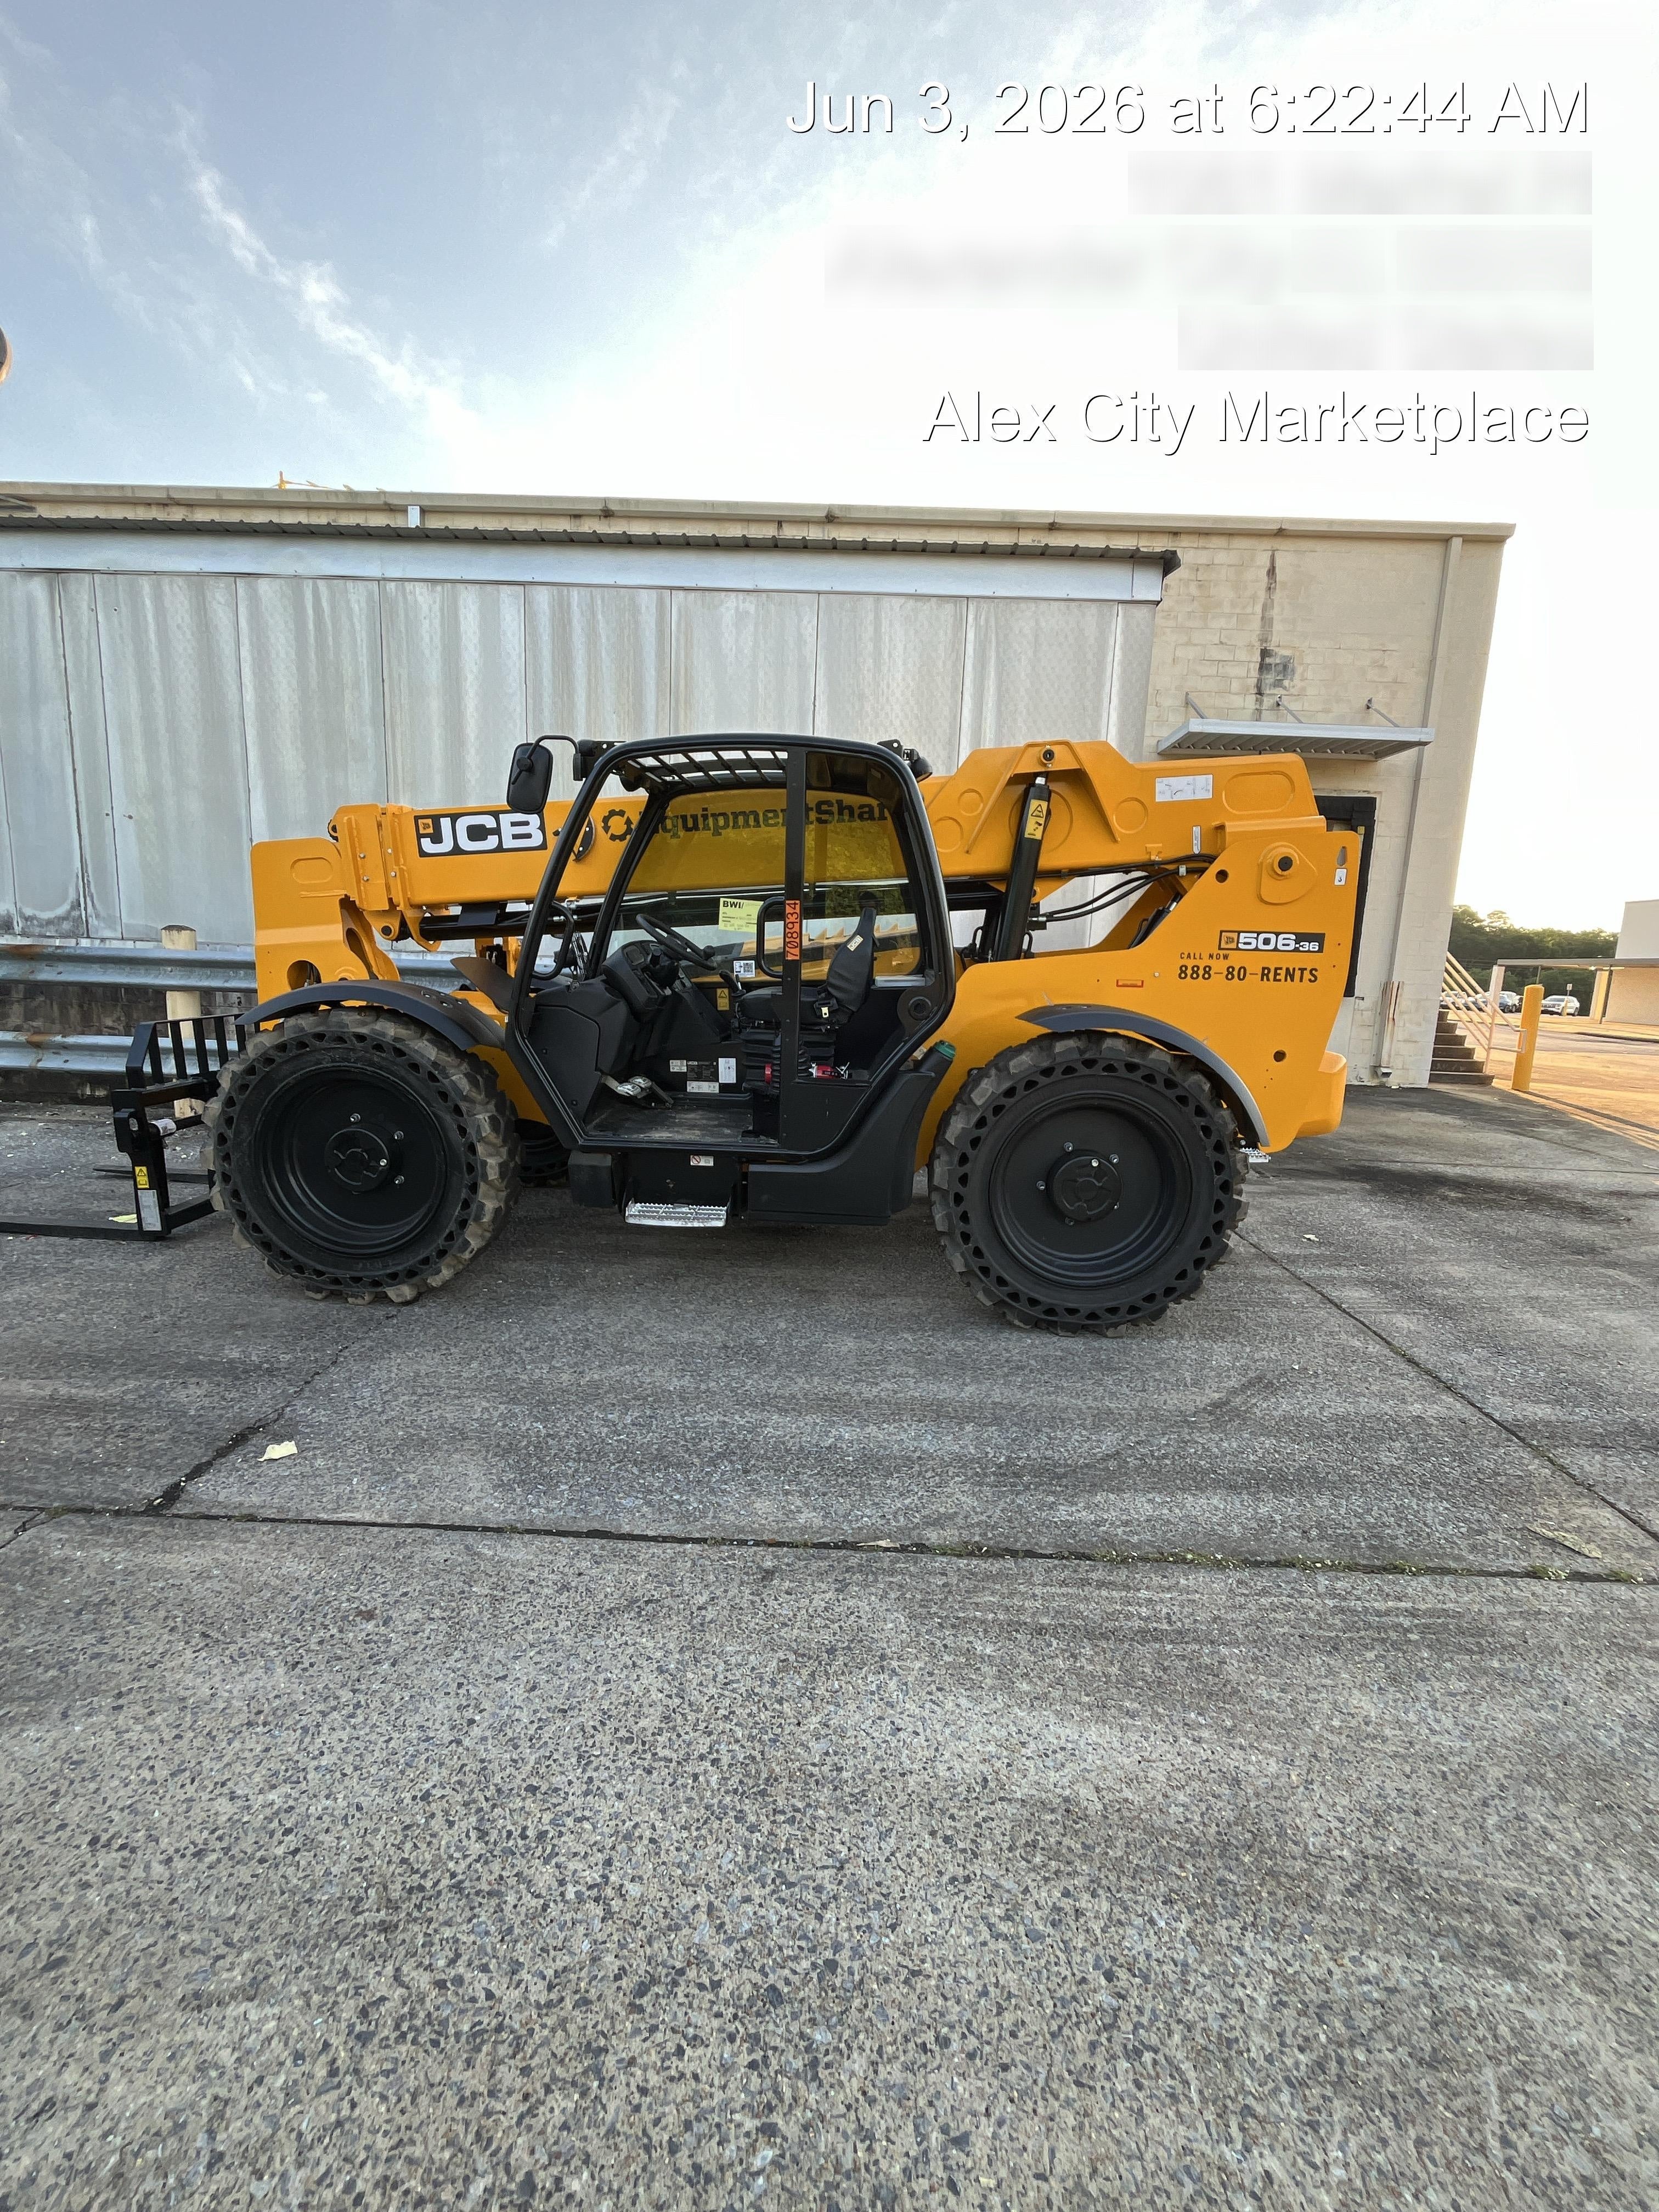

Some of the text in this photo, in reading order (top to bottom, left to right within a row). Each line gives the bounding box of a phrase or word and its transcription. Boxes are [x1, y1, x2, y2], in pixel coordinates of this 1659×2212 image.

[420, 812, 544, 854] JCB
[639, 799, 889, 839] quipmetShar
[787, 901, 799, 958] 708934
[1238, 932, 1319, 952] 506-36
[1208, 952, 1230, 961] NOW
[1178, 964, 1319, 983] 888-80-RENTS
